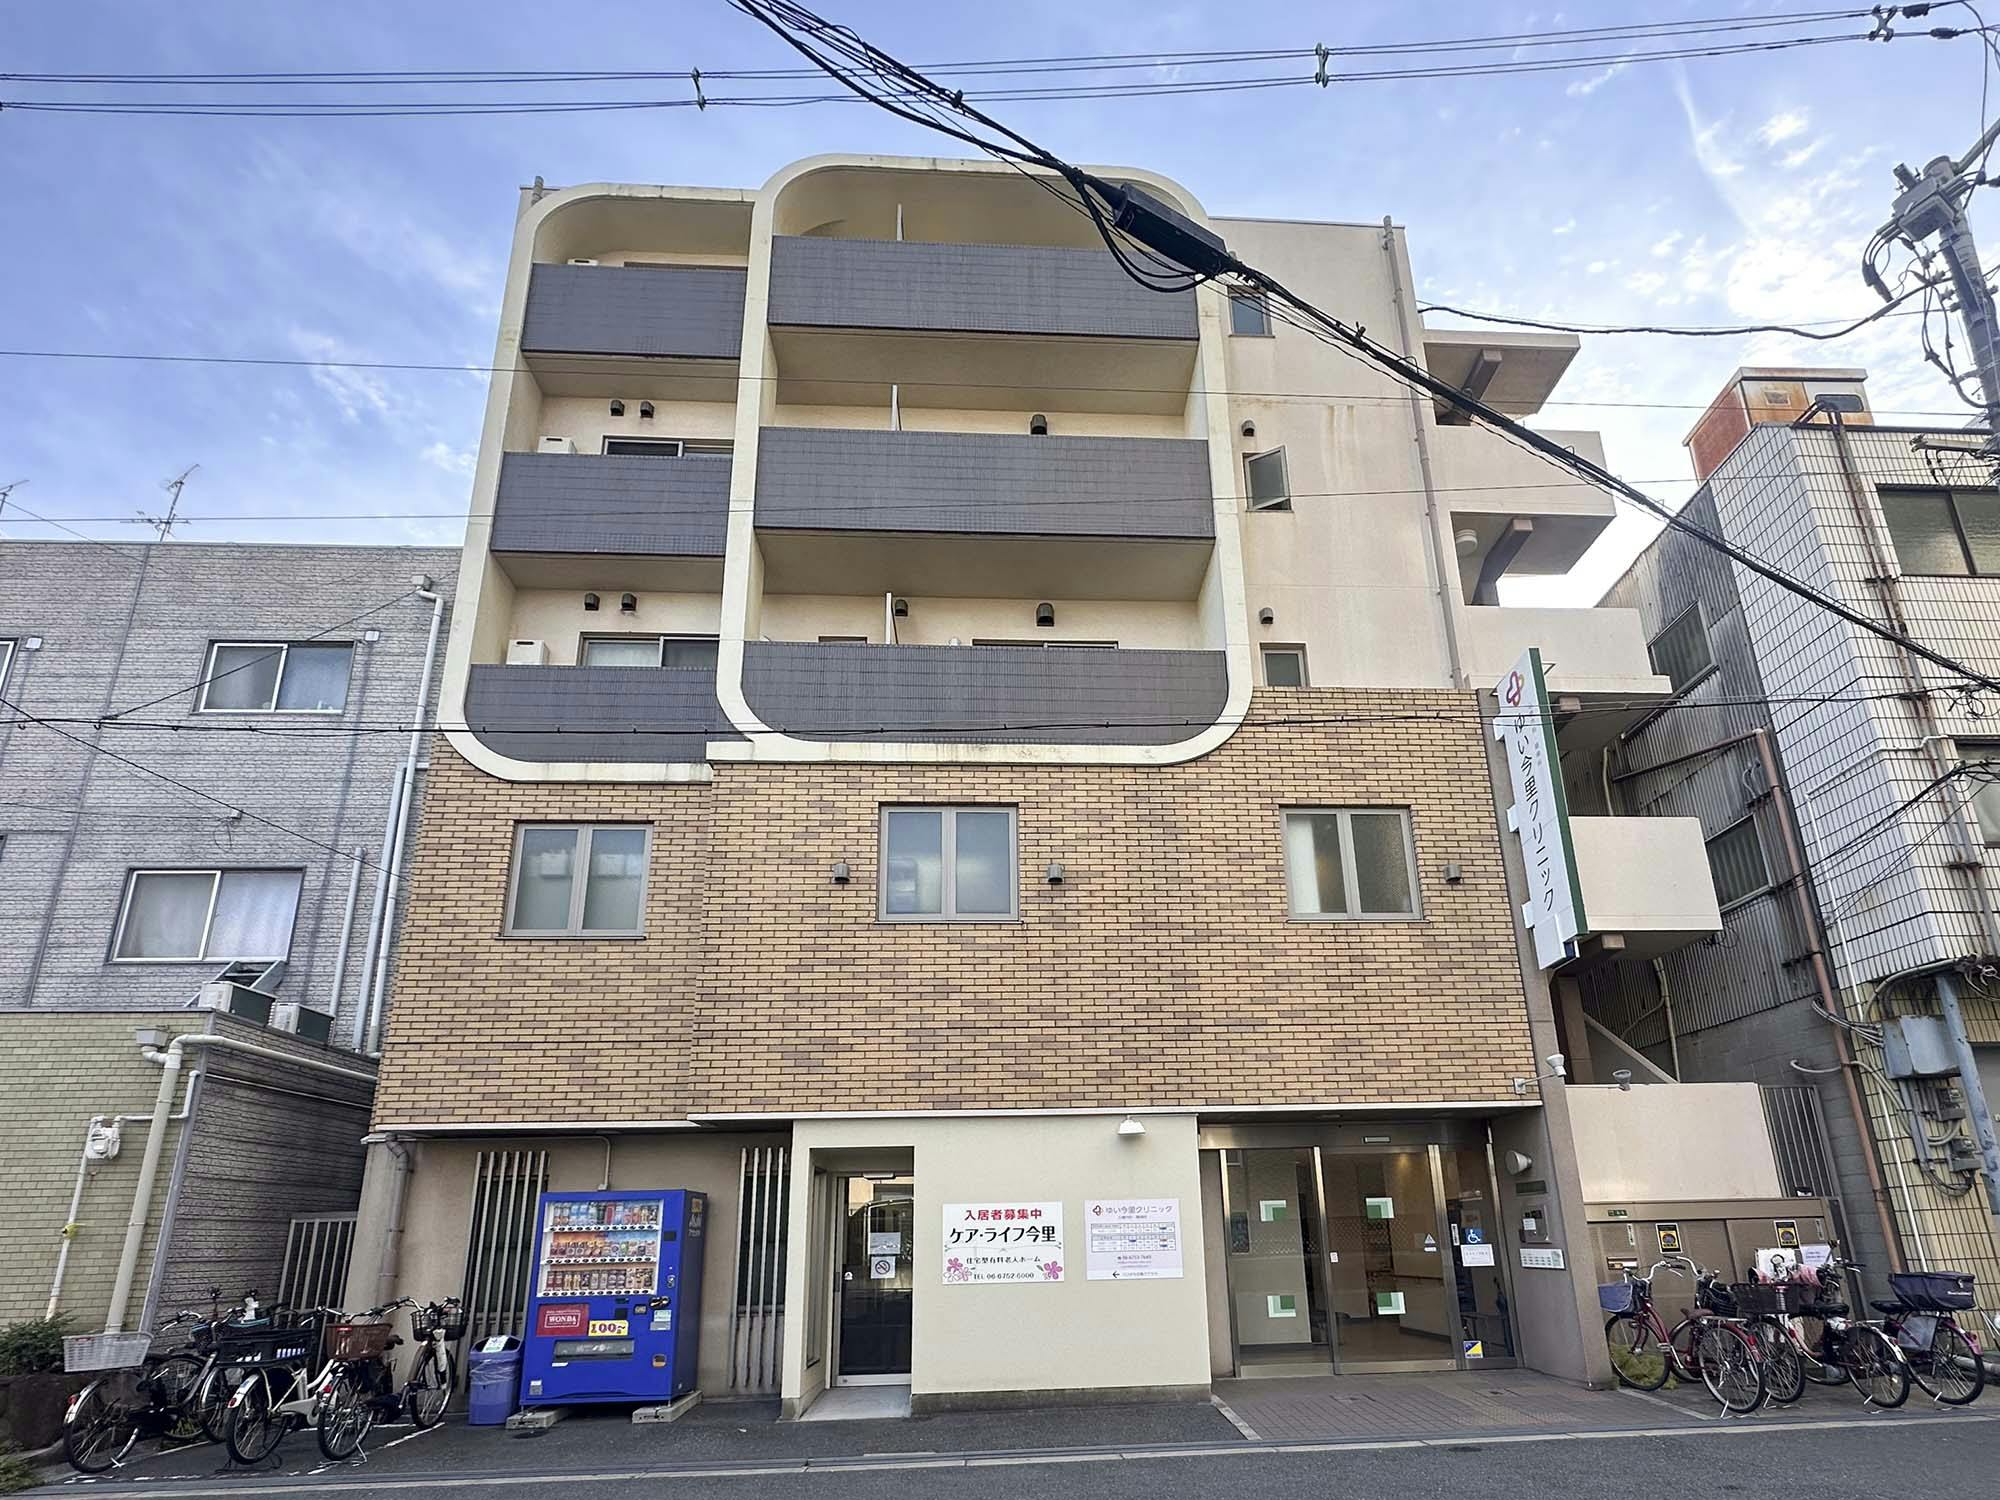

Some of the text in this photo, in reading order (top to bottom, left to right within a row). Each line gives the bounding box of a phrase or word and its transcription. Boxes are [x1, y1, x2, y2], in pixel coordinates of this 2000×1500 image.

[1513, 712, 1555, 913] ゆい今里クリニック
[964, 1208, 1042, 1221] 入居者募集中
[950, 1225, 1056, 1244] ケア・ライフ今里
[966, 1256, 1041, 1264] 住宅型有料老人ホーム
[548, 1315, 577, 1323] WONDA
